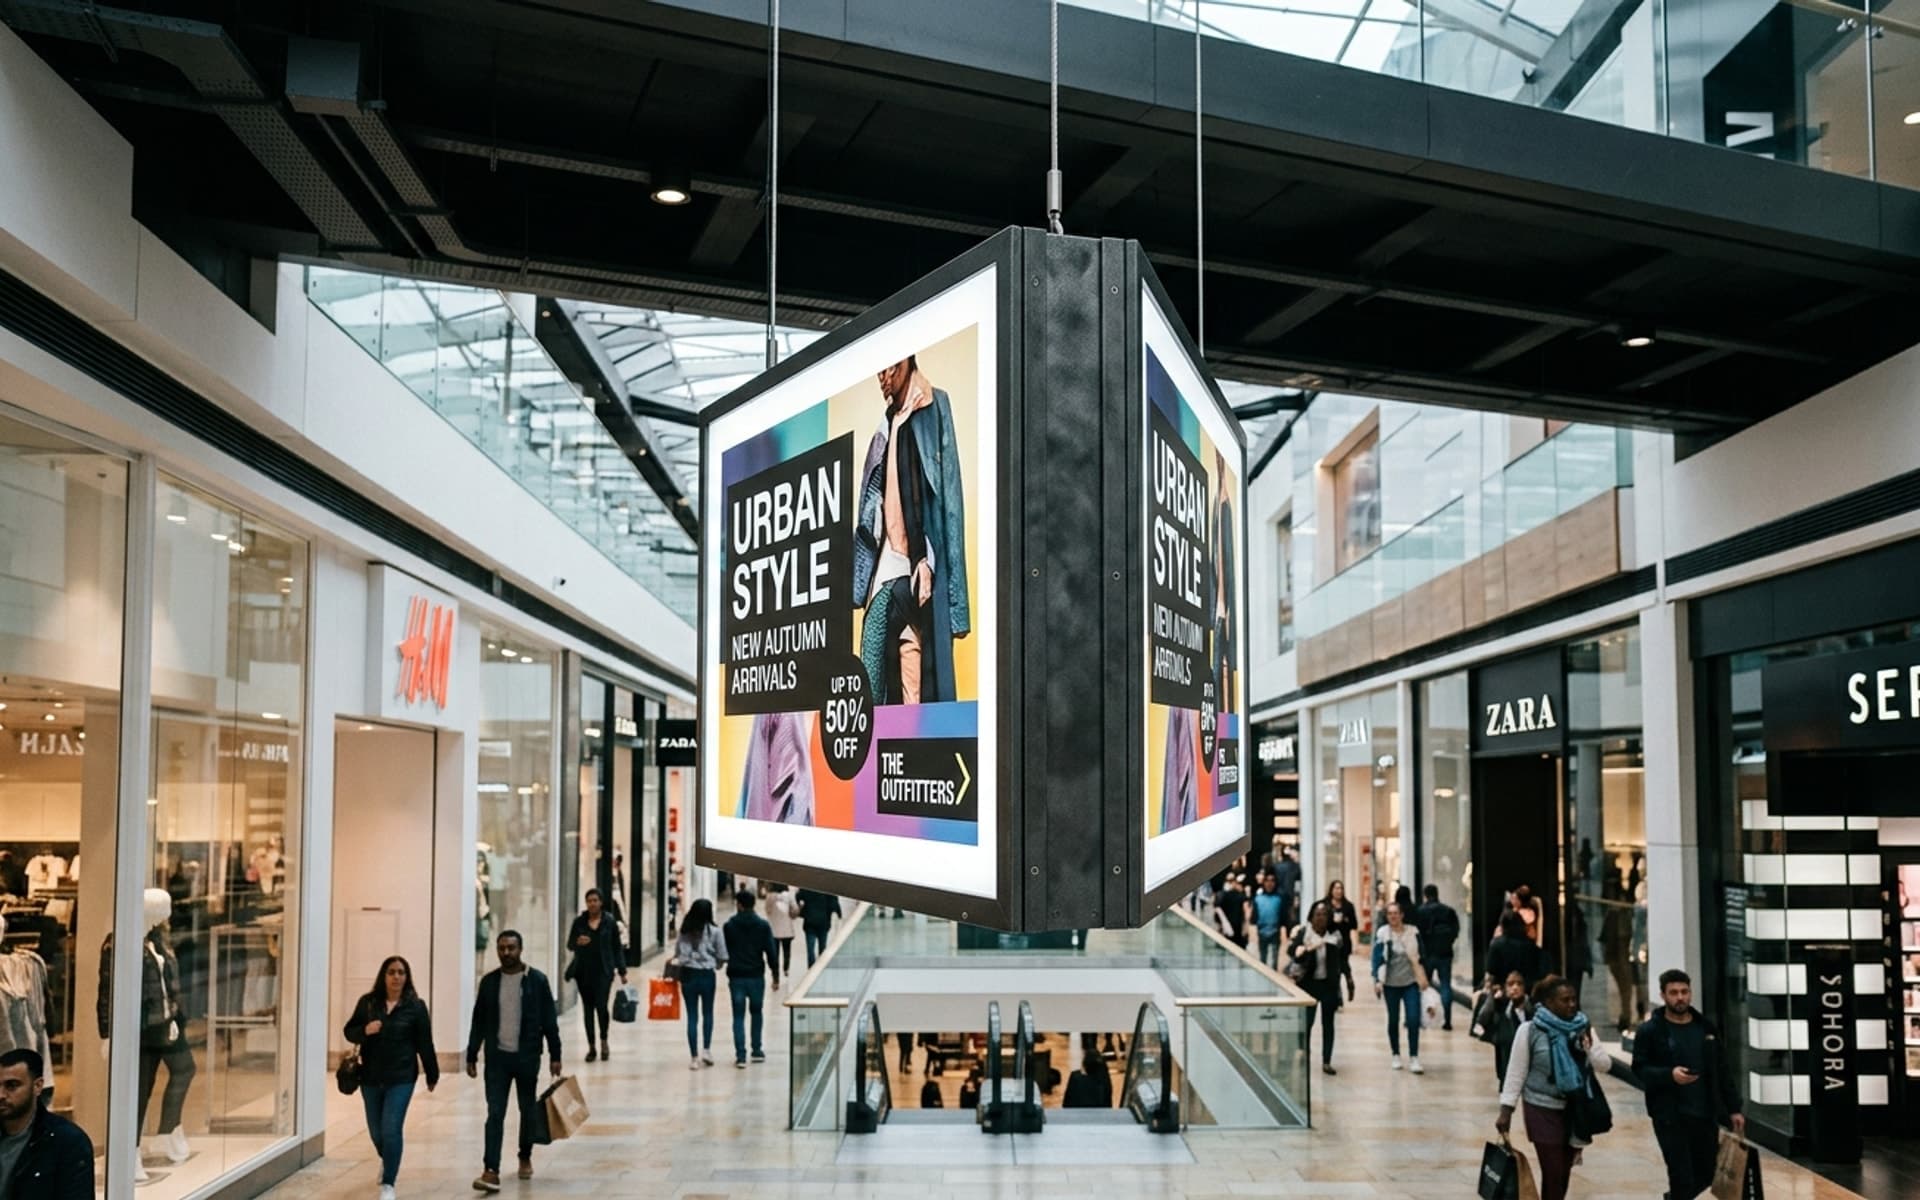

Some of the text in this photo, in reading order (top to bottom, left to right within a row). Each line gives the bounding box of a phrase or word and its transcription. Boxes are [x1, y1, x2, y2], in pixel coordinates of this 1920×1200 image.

[1153, 429, 1206, 544] URBAN
[733, 460, 841, 555] URBAN
[732, 538, 830, 620] STYLE
[1153, 514, 1202, 608] STYLE
[732, 618, 826, 662] NEW AUTUMN
[731, 660, 797, 695] ARRIVALS
[831, 675, 861, 694] UP TO
[826, 696, 867, 733] 50%
[1486, 693, 1557, 737] ZARA
[660, 737, 698, 749] ZARA
[834, 737, 858, 759] OFF
[881, 752, 904, 775] THE
[881, 778, 955, 805] OUTFITTERS
